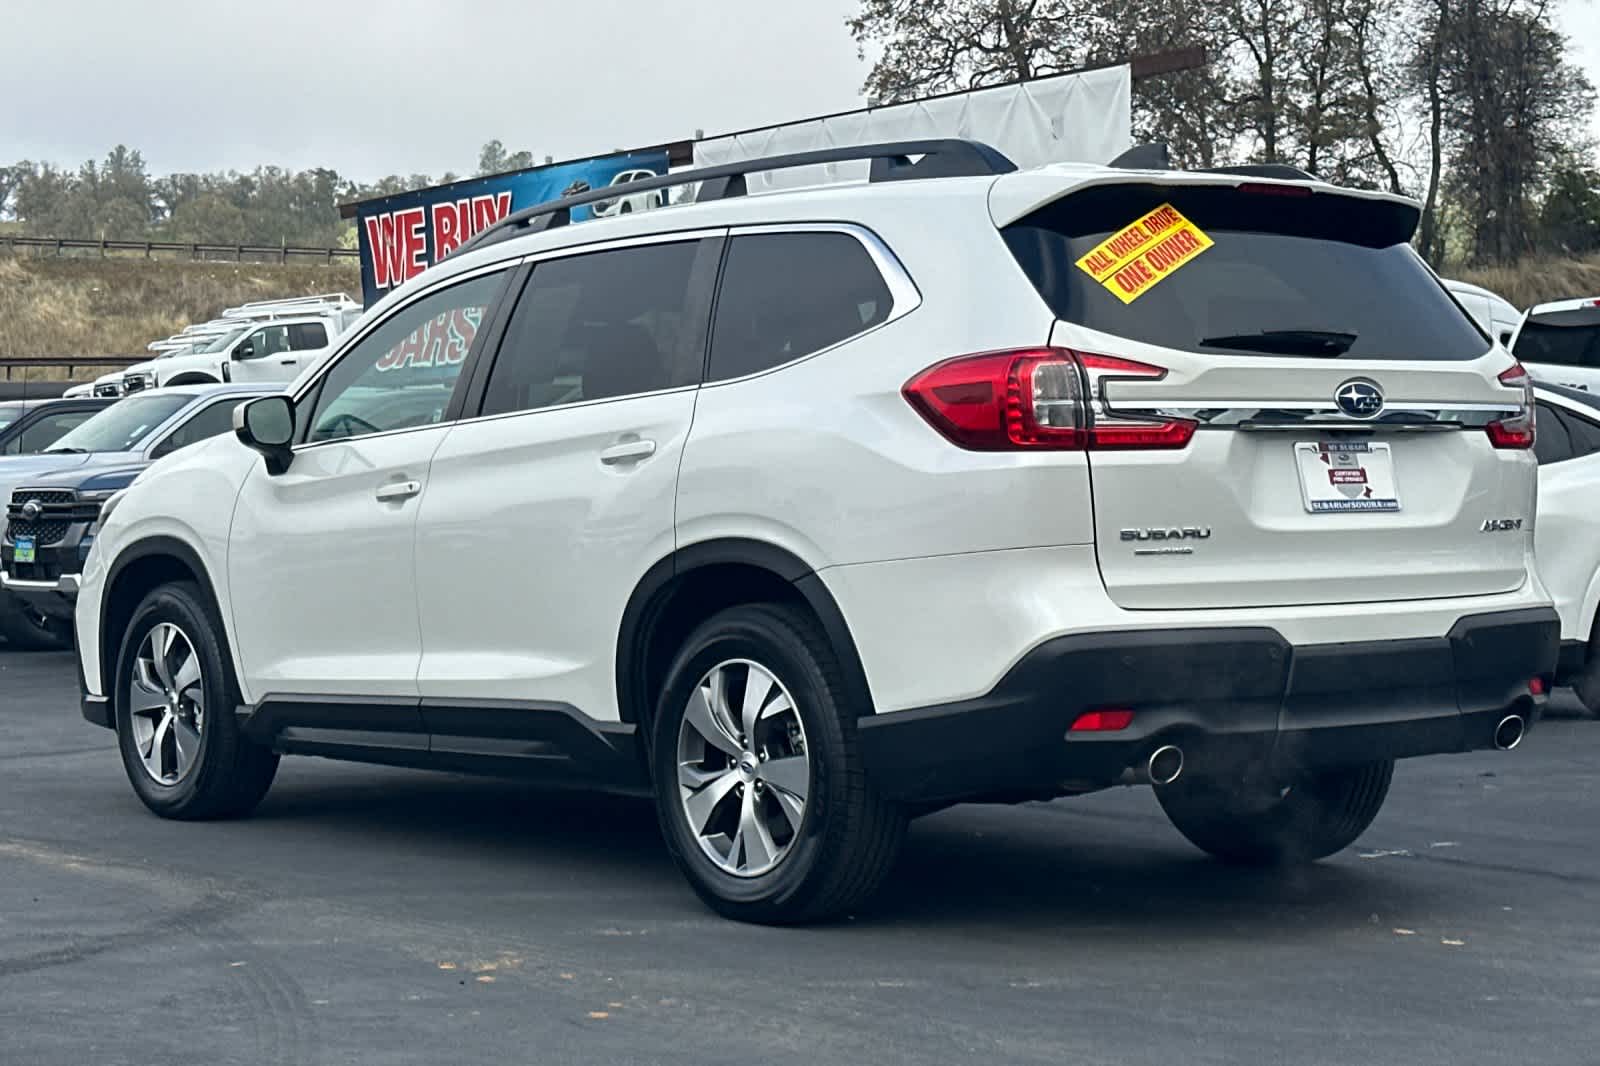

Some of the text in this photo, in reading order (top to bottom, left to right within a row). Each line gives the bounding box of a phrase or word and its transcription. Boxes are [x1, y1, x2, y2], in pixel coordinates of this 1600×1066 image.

[364, 206, 428, 289] WE
[1084, 206, 1182, 276] ALL WHEEL DRIVE
[1114, 228, 1202, 294] ONE OWNER
[1120, 527, 1211, 541] SUBARU
